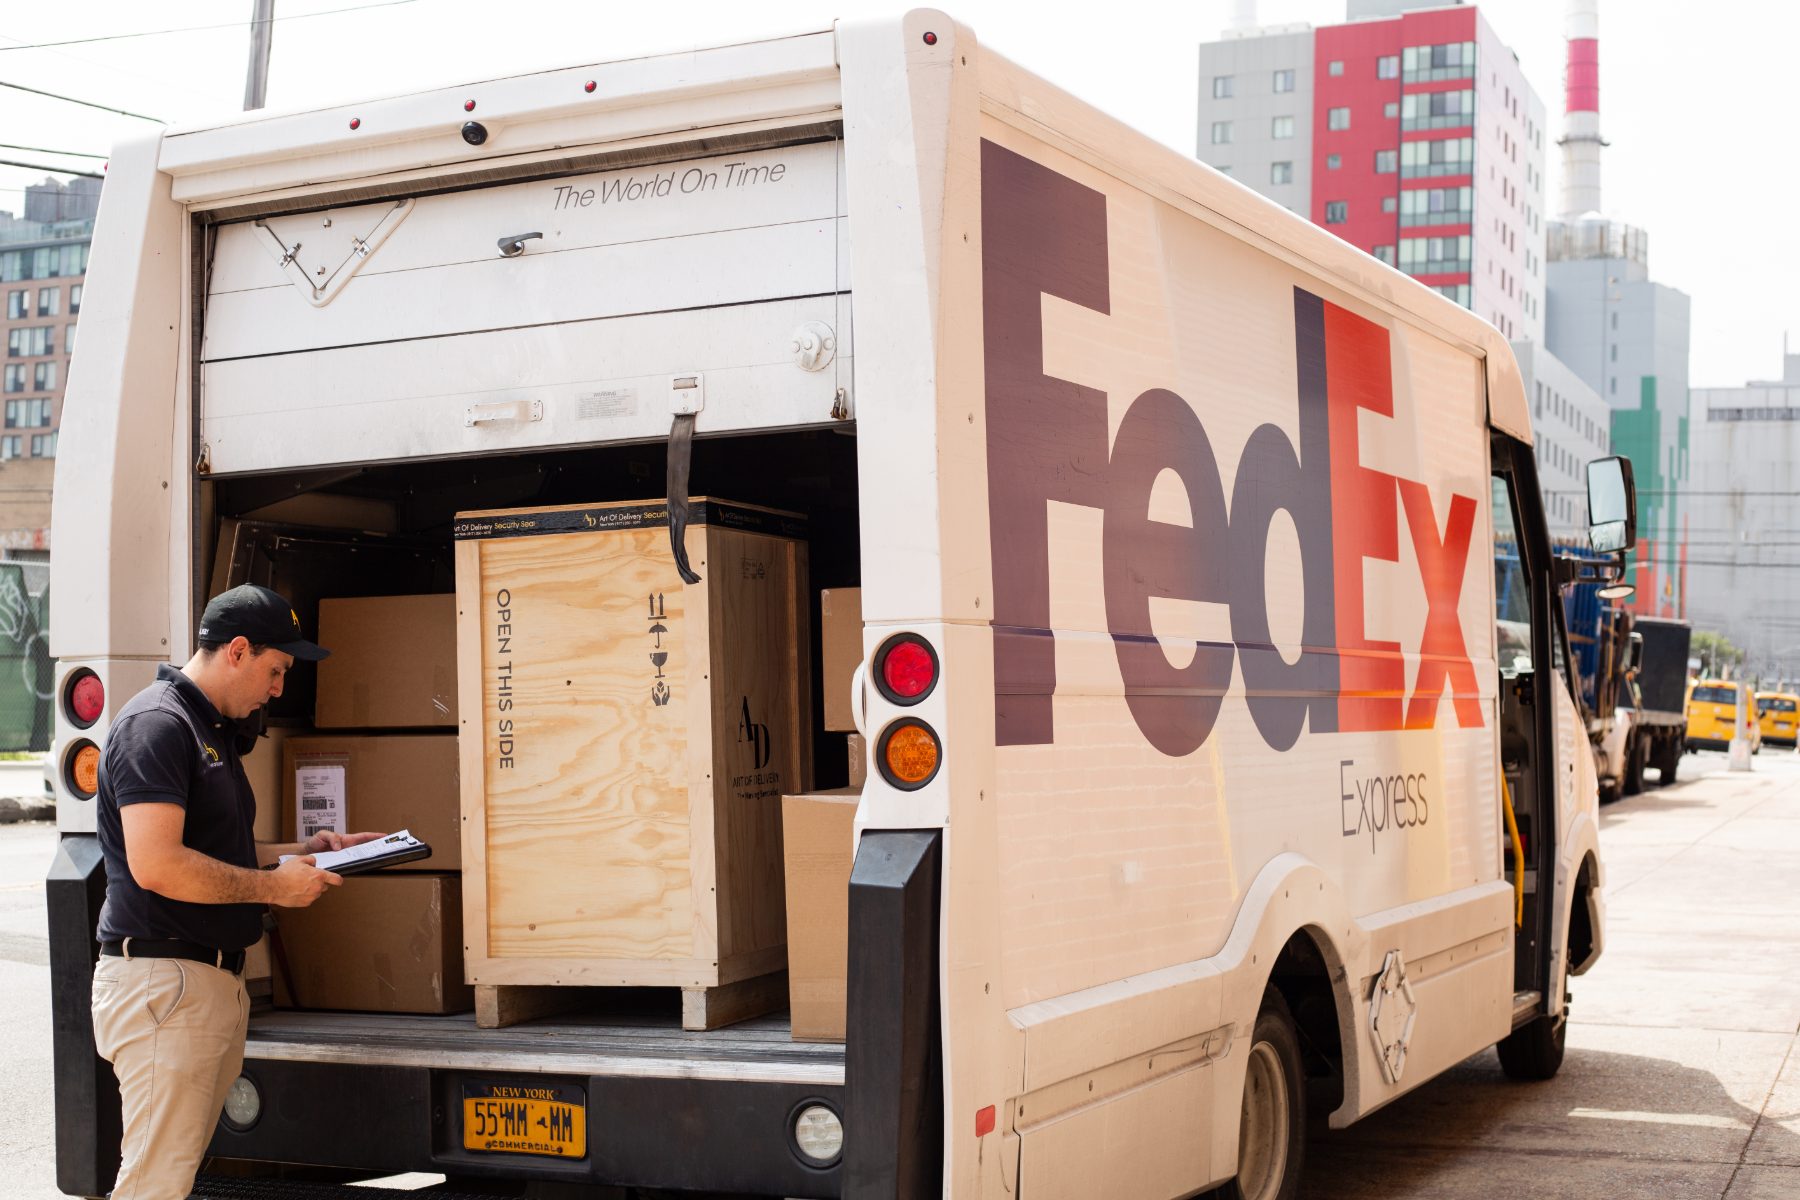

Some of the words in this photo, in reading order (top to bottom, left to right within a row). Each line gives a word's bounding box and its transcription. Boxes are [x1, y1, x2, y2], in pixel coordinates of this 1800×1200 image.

[553, 185, 595, 210] The
[601, 171, 675, 204] World
[680, 168, 718, 194] On
[724, 162, 786, 189] Time
[980, 136, 1486, 757] FedEx
[461, 524, 469, 532] Of
[470, 523, 492, 531] Delivery
[494, 520, 520, 530] Security
[599, 514, 608, 522] Art
[609, 513, 617, 521] Of
[618, 512, 641, 521] Delivery
[496, 588, 512, 654] OPEN
[498, 661, 513, 711] THIS
[498, 719, 514, 769] SIDE
[732, 776, 743, 787] ART
[744, 775, 752, 786] OF
[753, 772, 779, 785] DELIVERY
[1340, 760, 1428, 855] Express
[492, 1086, 521, 1097] NEW
[523, 1087, 555, 1100] YORK
[490, 1140, 558, 1152] COMMERCIAL
